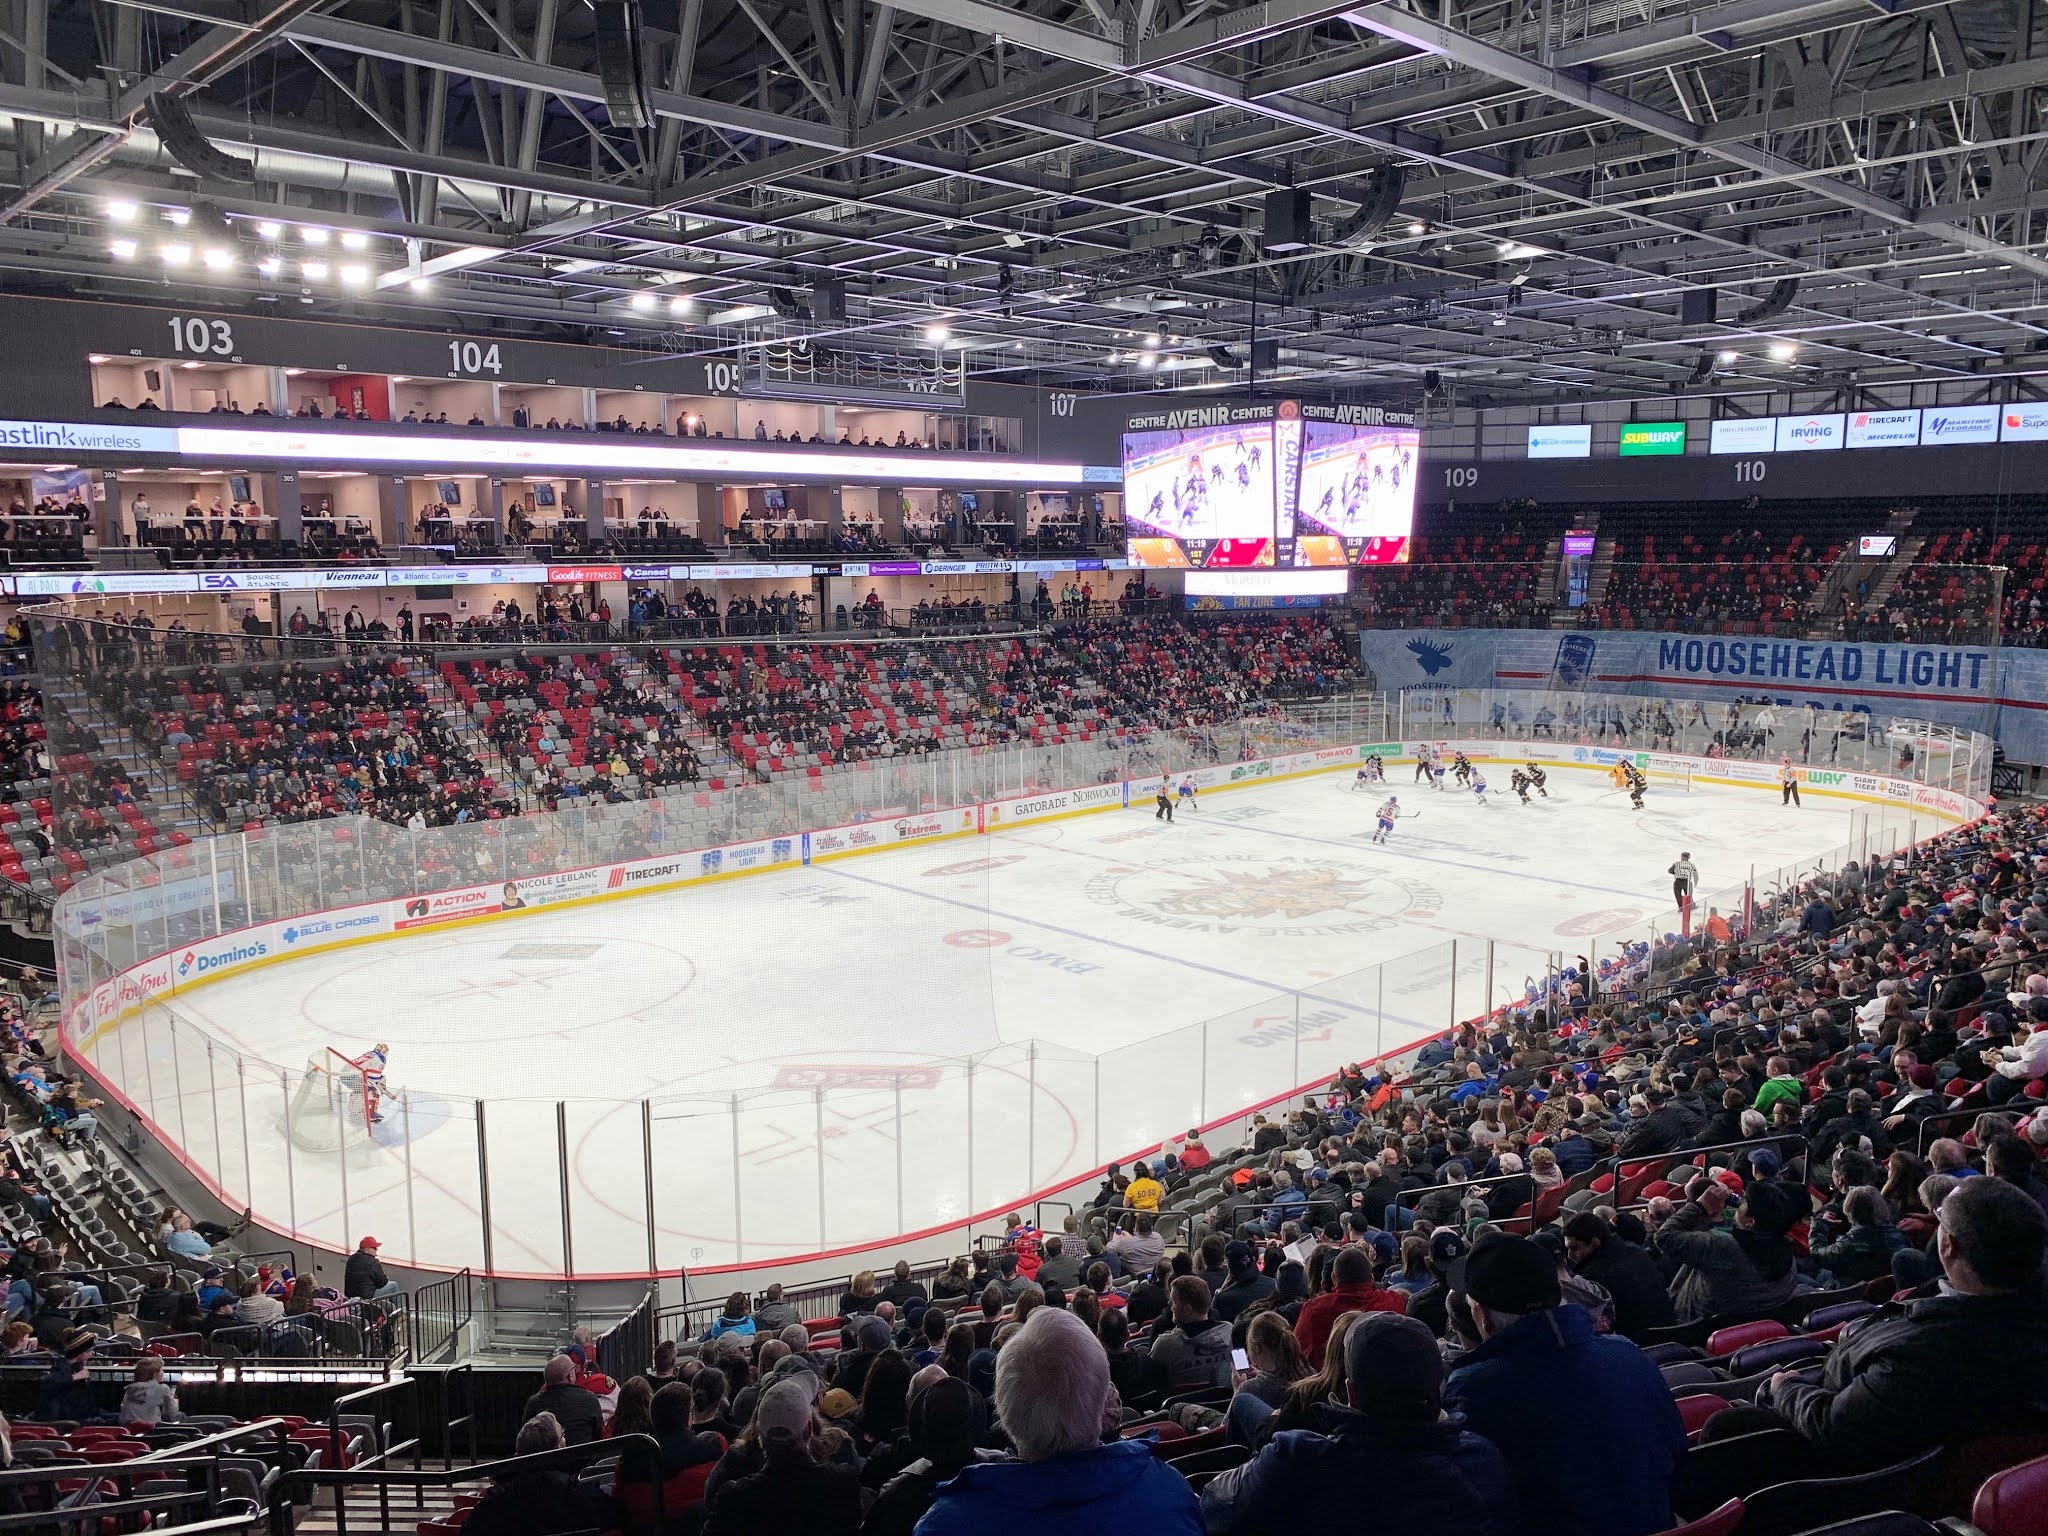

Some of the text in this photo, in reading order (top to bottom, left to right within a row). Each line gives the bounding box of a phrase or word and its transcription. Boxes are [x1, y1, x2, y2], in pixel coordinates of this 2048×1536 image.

[168, 317, 234, 355] 103
[449, 340, 502, 374] 104
[337, 363, 347, 371] 403
[1050, 393, 1077, 417] 107
[1128, 405, 1274, 430] CENTRE AVENIR CENTRE
[1302, 404, 1414, 425] CENTRE AVENIR CENTRE
[1869, 415, 1913, 424] TIRECRAFT
[1622, 430, 1684, 444] SUBWAY
[1791, 427, 1832, 438] IRVING
[79, 433, 141, 449] wireless
[104, 471, 116, 479] 304
[1735, 460, 1766, 482] 110
[1284, 440, 1298, 519] CARSTAR
[1445, 468, 1478, 487] 109
[1187, 539, 1206, 548] 11:19
[1222, 540, 1231, 552] 0
[1347, 538, 1362, 546] 11:19
[1374, 538, 1381, 550] 0
[634, 568, 668, 577] Cansel
[933, 564, 966, 572] DERINGER
[326, 571, 379, 581] Vienneau
[404, 572, 430, 580] Atlantic
[431, 572, 454, 580] Carrier
[551, 570, 619, 580] GoodLife FITNESS
[205, 575, 239, 588] SA
[1233, 596, 1275, 608] FAN ZONE
[1296, 597, 1317, 606] pepsi
[1659, 639, 1988, 689] MOOSEHEAD LIGHT
[1315, 748, 1353, 759] TOMAVO
[1380, 747, 1400, 755] Homes
[1776, 768, 1847, 785] SBWAY
[1854, 776, 1877, 785] GIANT
[1854, 783, 1877, 791] TIGER
[1889, 781, 1910, 791] TIGRE
[1072, 786, 1120, 803] NORWOOD
[1915, 789, 1934, 806] Tim
[1015, 797, 1067, 816] GATORADE
[1386, 807, 1395, 817] 5
[850, 829, 870, 840] trailer
[907, 822, 942, 835] Extreme
[816, 835, 838, 846] trailer
[819, 839, 845, 851] wizards
[852, 834, 877, 845] wizards
[729, 846, 766, 860] MOOSEHEAD
[739, 855, 757, 867] LIGHT
[625, 863, 681, 882] TIRECRAFT
[517, 869, 598, 890] NICOLE LEBLANC
[433, 891, 487, 908] ACTION
[406, 908, 488, 928] www.actioncarandtruck.com
[300, 915, 380, 937] BLUE CROSS
[197, 941, 267, 971] Domino's
[1006, 946, 1104, 975] BMO
